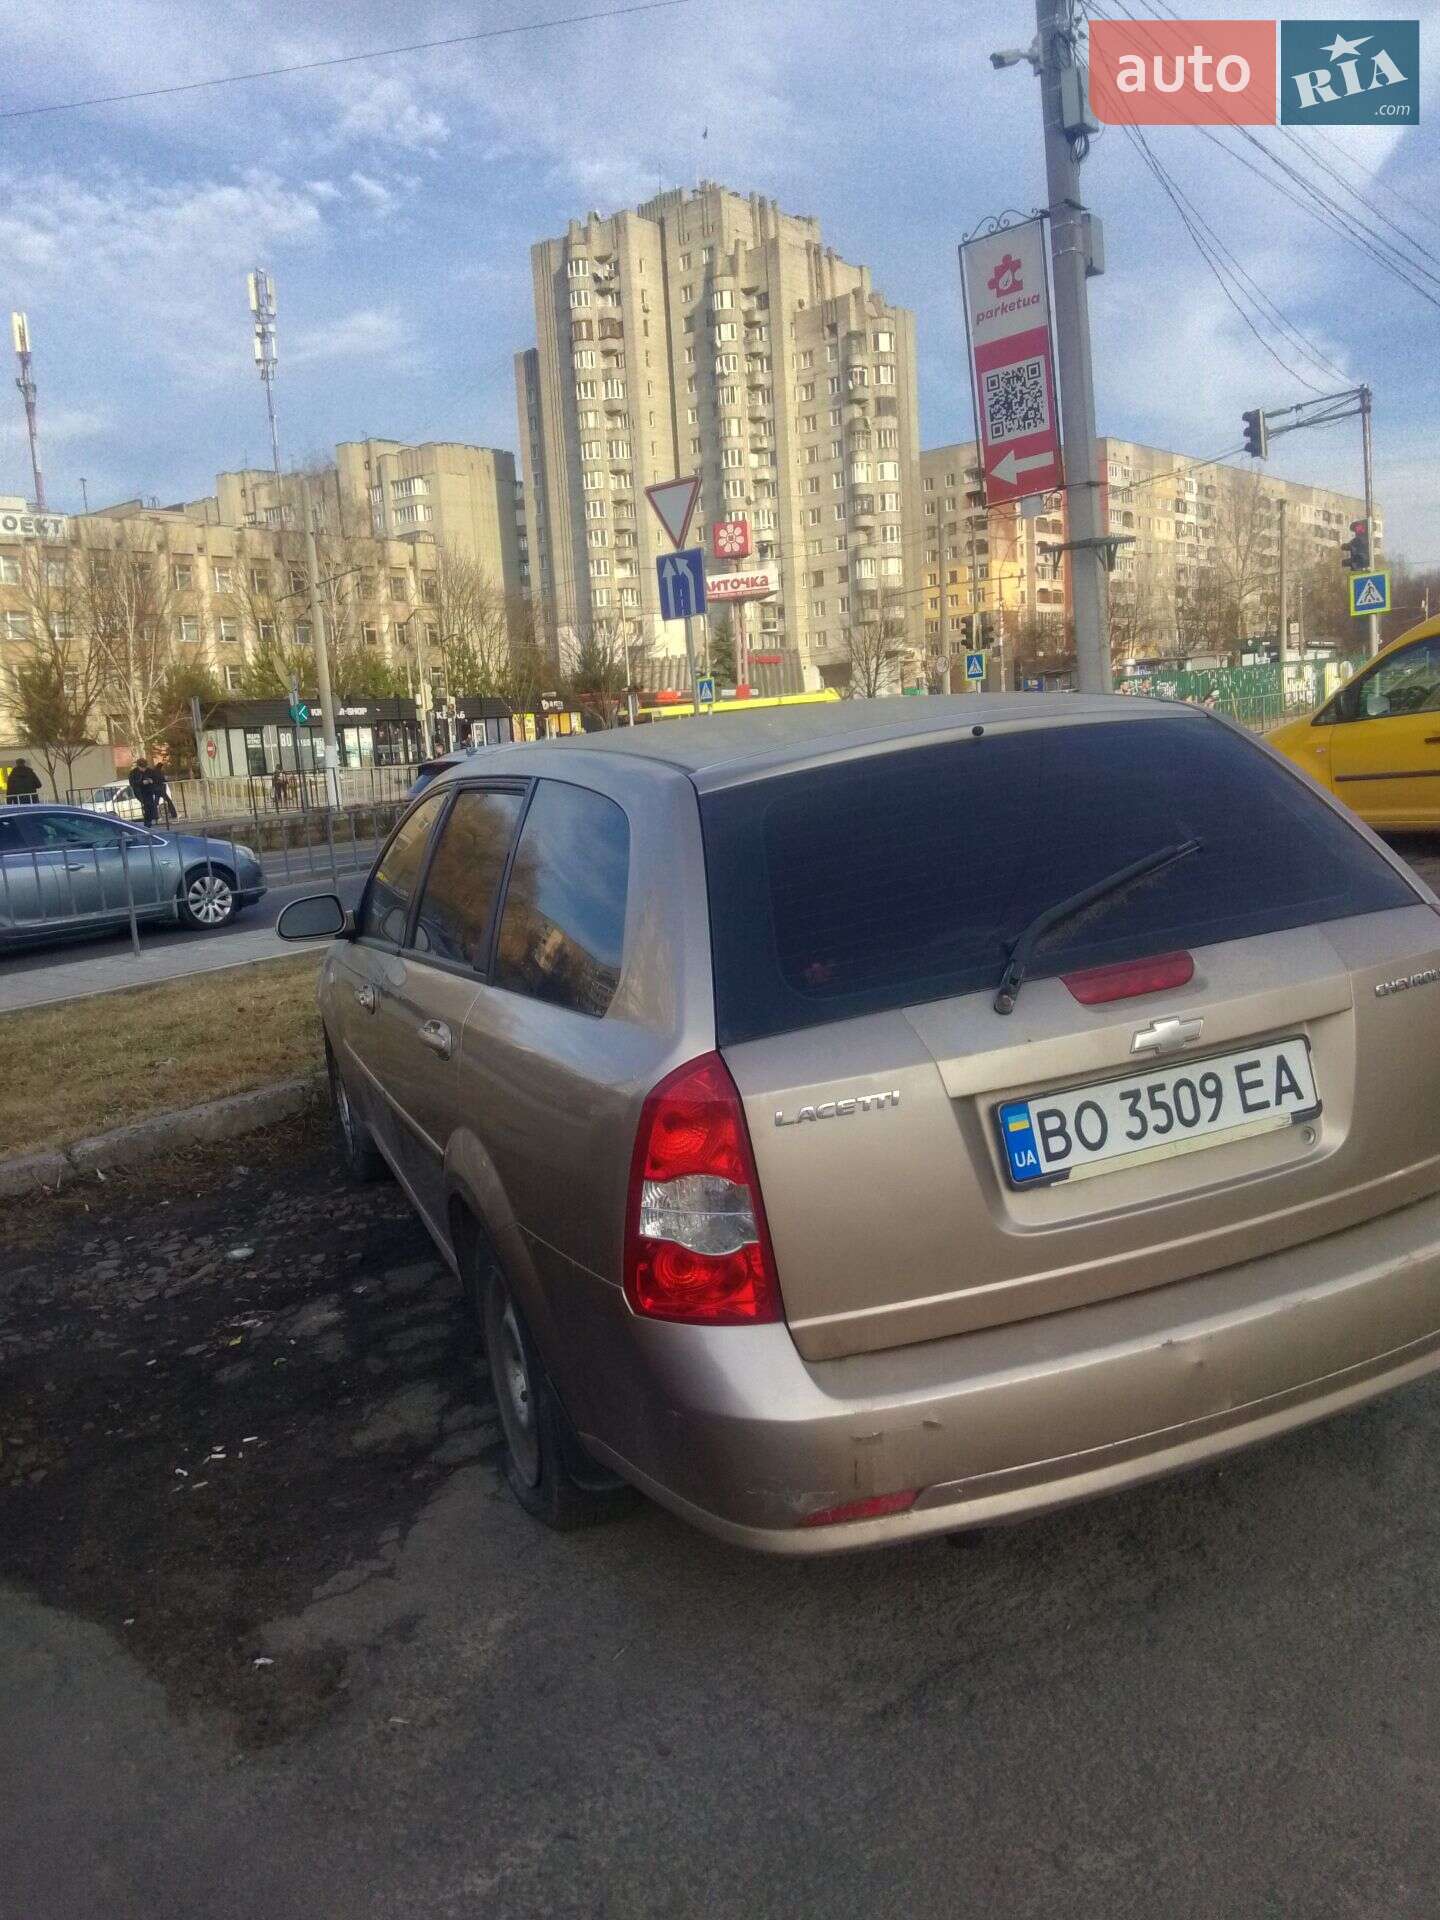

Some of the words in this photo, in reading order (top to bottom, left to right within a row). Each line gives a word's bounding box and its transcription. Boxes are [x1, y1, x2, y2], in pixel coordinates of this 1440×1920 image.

[976, 293, 1041, 326] parketua
[774, 1089, 900, 1127] LACETTI
[1036, 1099, 1108, 1163] BO
[1119, 1071, 1223, 1141] 3509
[1234, 1054, 1304, 1114] EA
[1014, 1149, 1037, 1168] UA
